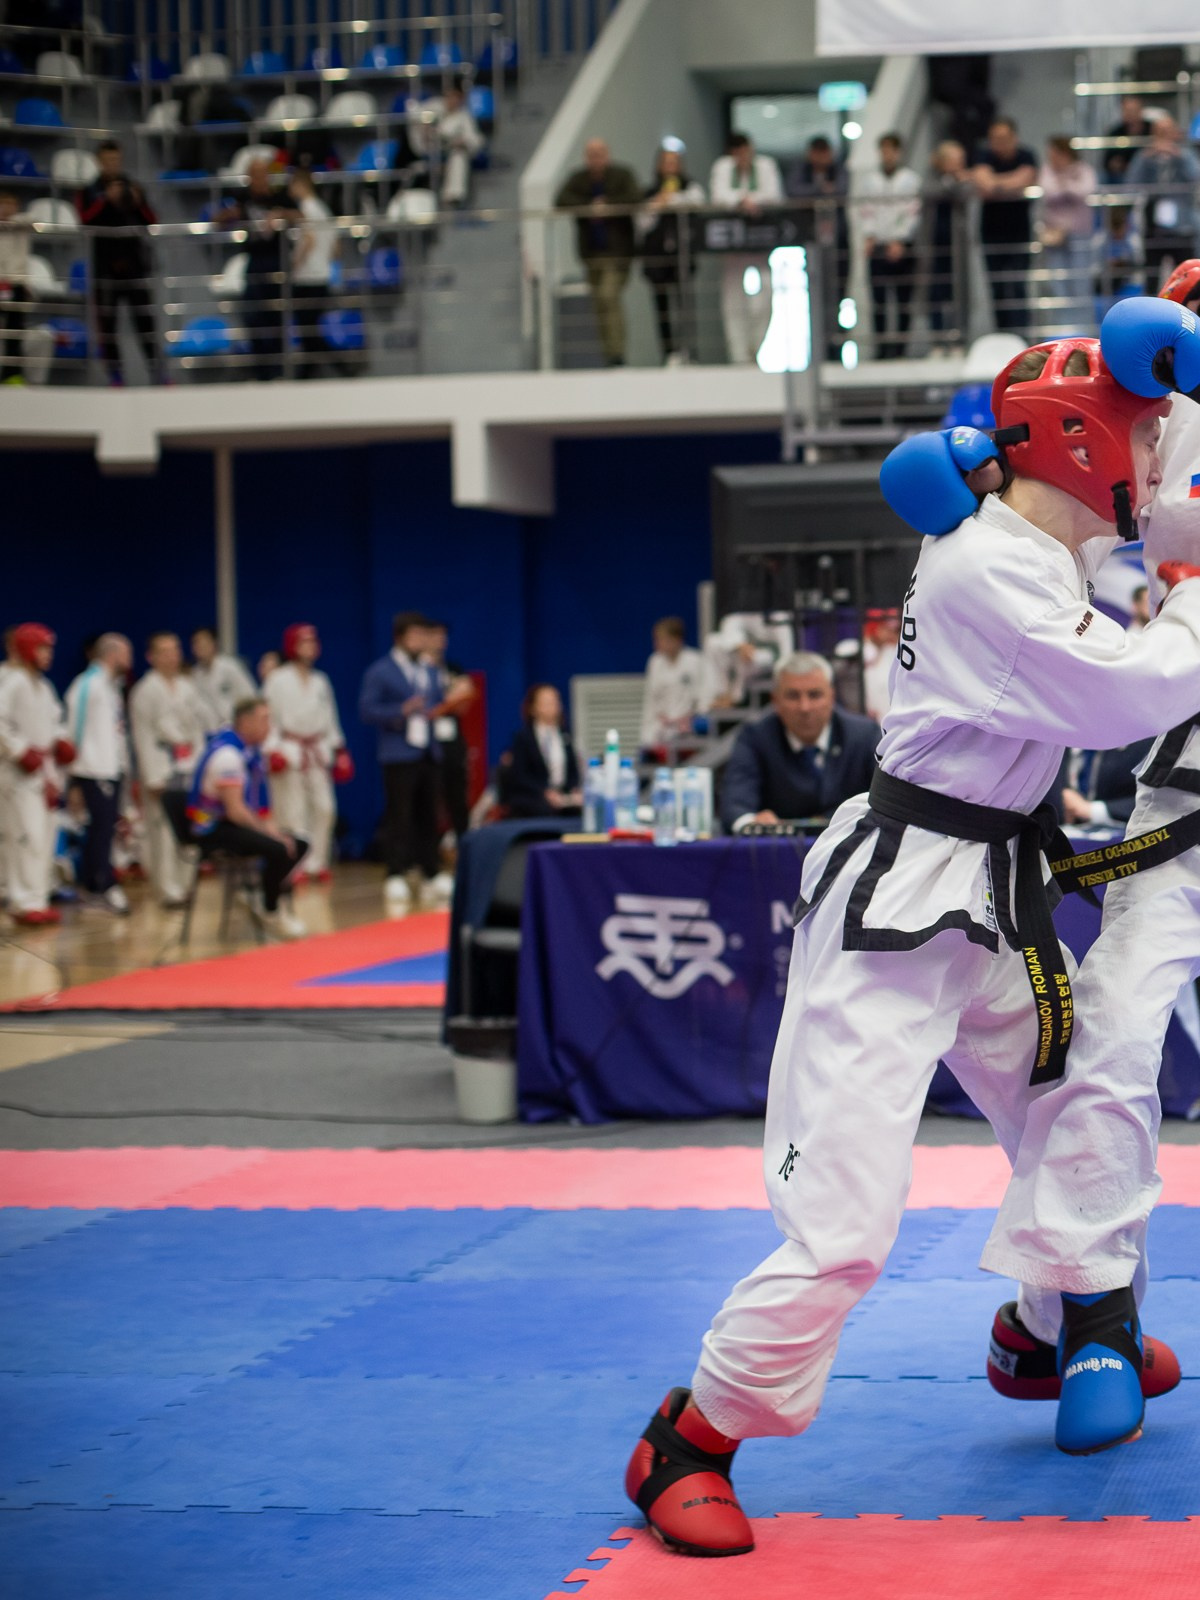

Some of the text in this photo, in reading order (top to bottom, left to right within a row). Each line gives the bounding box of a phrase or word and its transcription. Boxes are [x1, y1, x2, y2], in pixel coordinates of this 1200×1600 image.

[1105, 828, 1171, 862] TAEKWON-DO
[1051, 854, 1105, 874] FEDERATIO
[1077, 861, 1138, 888] ALL RUSSIA
[1024, 947, 1048, 994] ROMAN
